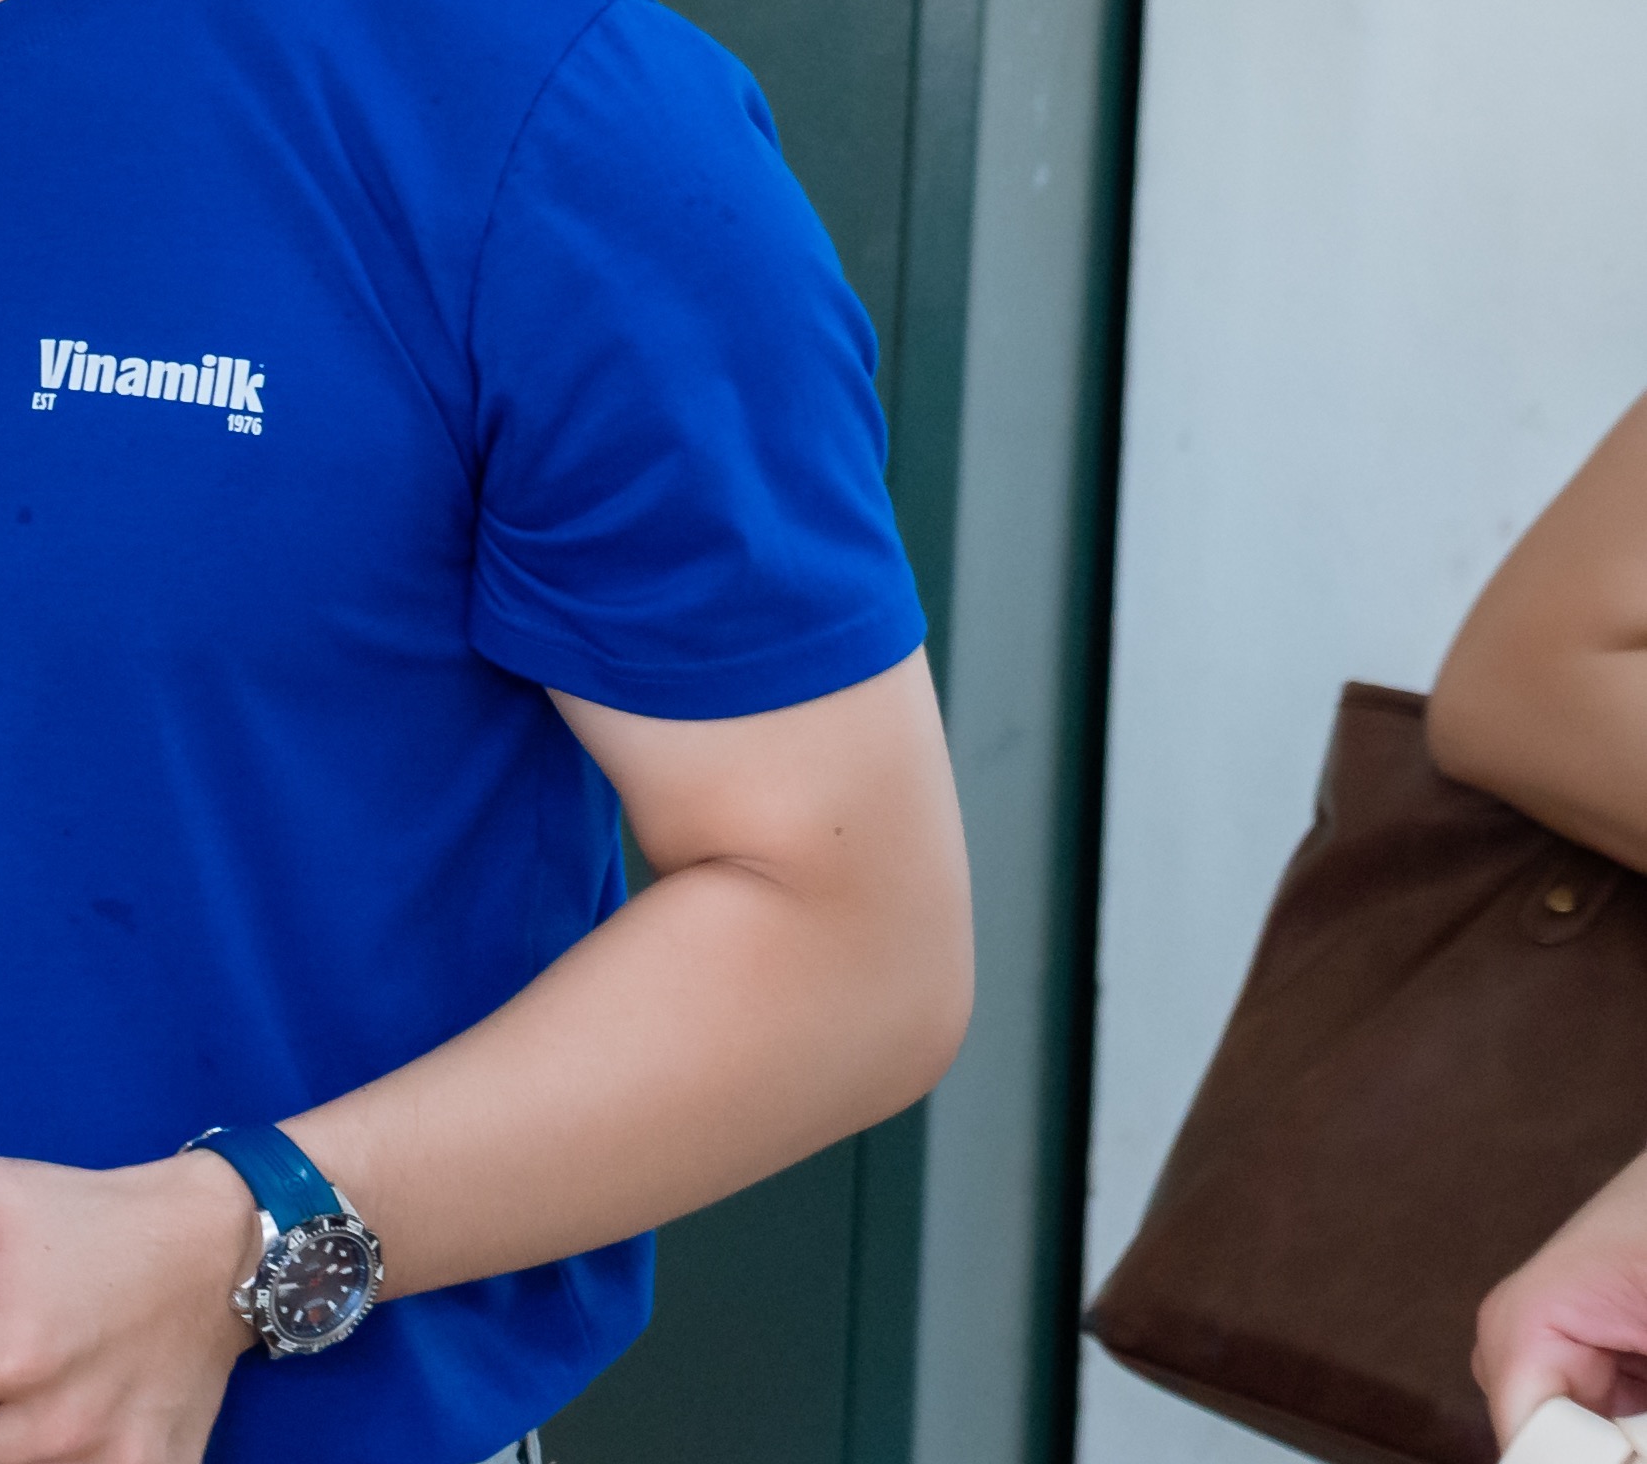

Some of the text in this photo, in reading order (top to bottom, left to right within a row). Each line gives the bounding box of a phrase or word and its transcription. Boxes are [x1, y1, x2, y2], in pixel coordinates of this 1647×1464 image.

[40, 338, 265, 413] Vinamilk
[31, 392, 57, 411] EST
[227, 413, 263, 436] 1976
